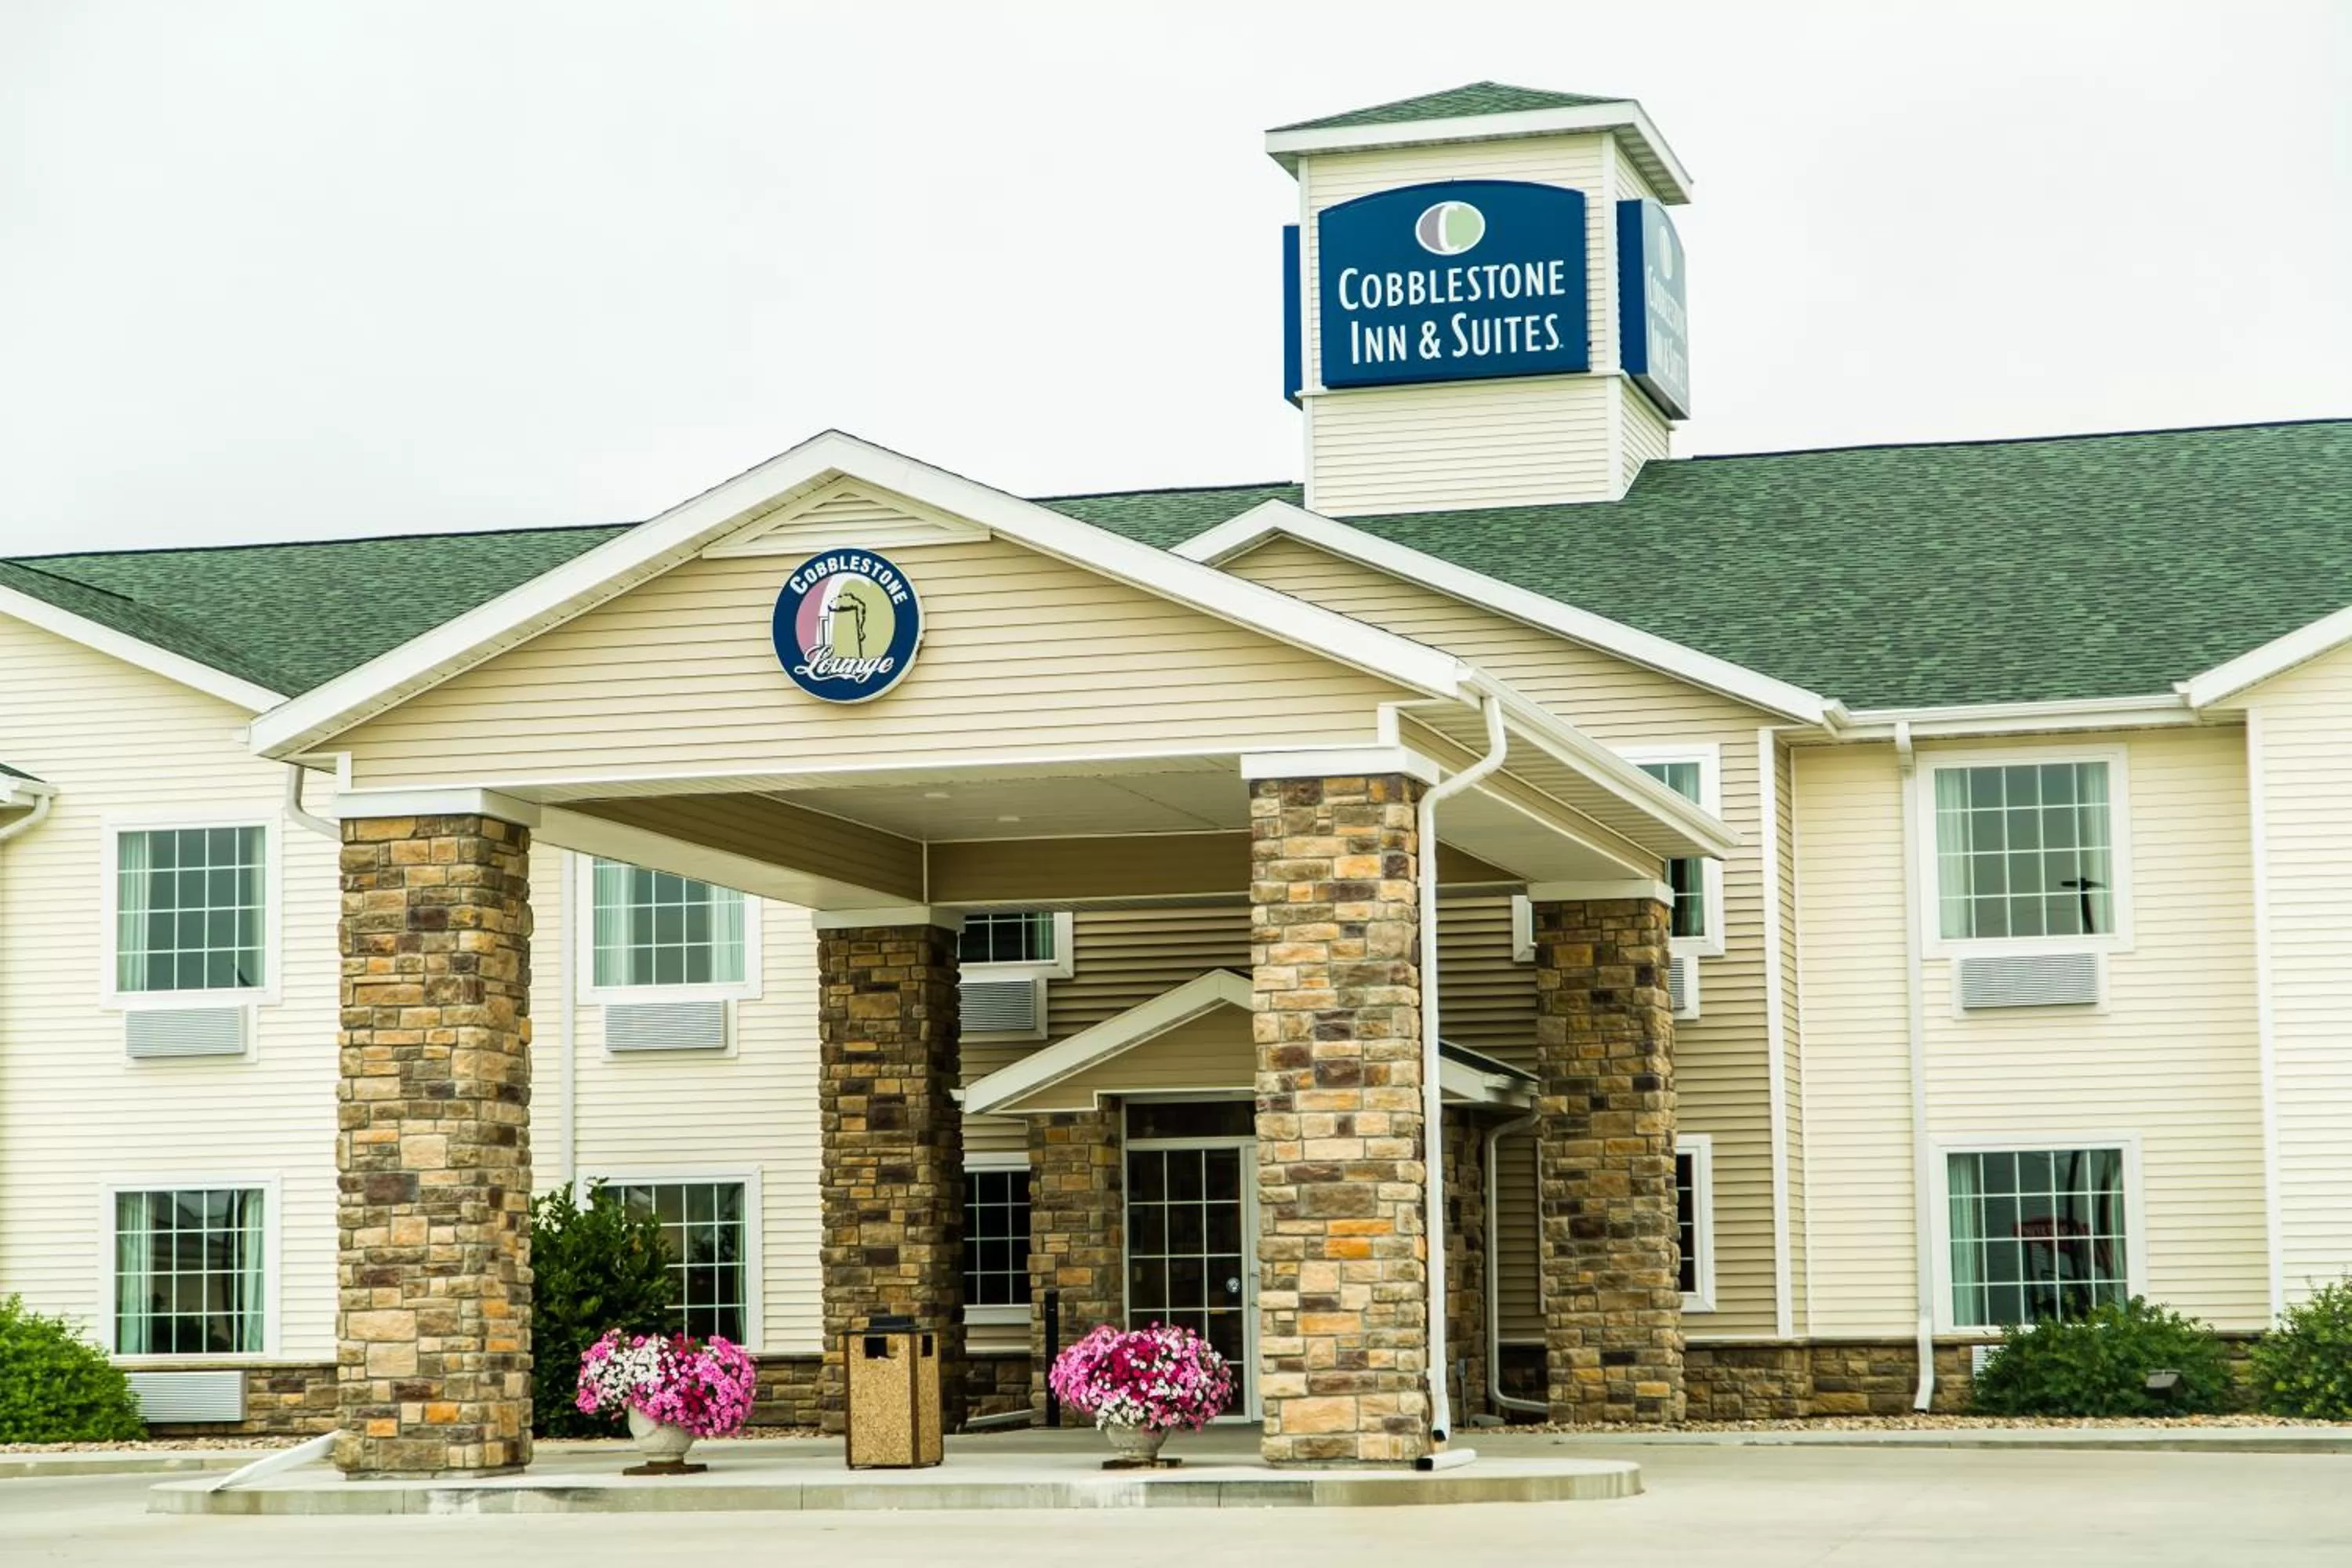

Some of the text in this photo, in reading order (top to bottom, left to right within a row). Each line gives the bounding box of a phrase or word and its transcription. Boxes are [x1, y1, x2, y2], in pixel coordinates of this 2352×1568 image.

[1338, 260, 1565, 310] COBBLESTONE
[1351, 312, 1560, 365] INN & SUITES
[789, 555, 909, 605] COBBLESTONE
[794, 645, 895, 684] Lounge
